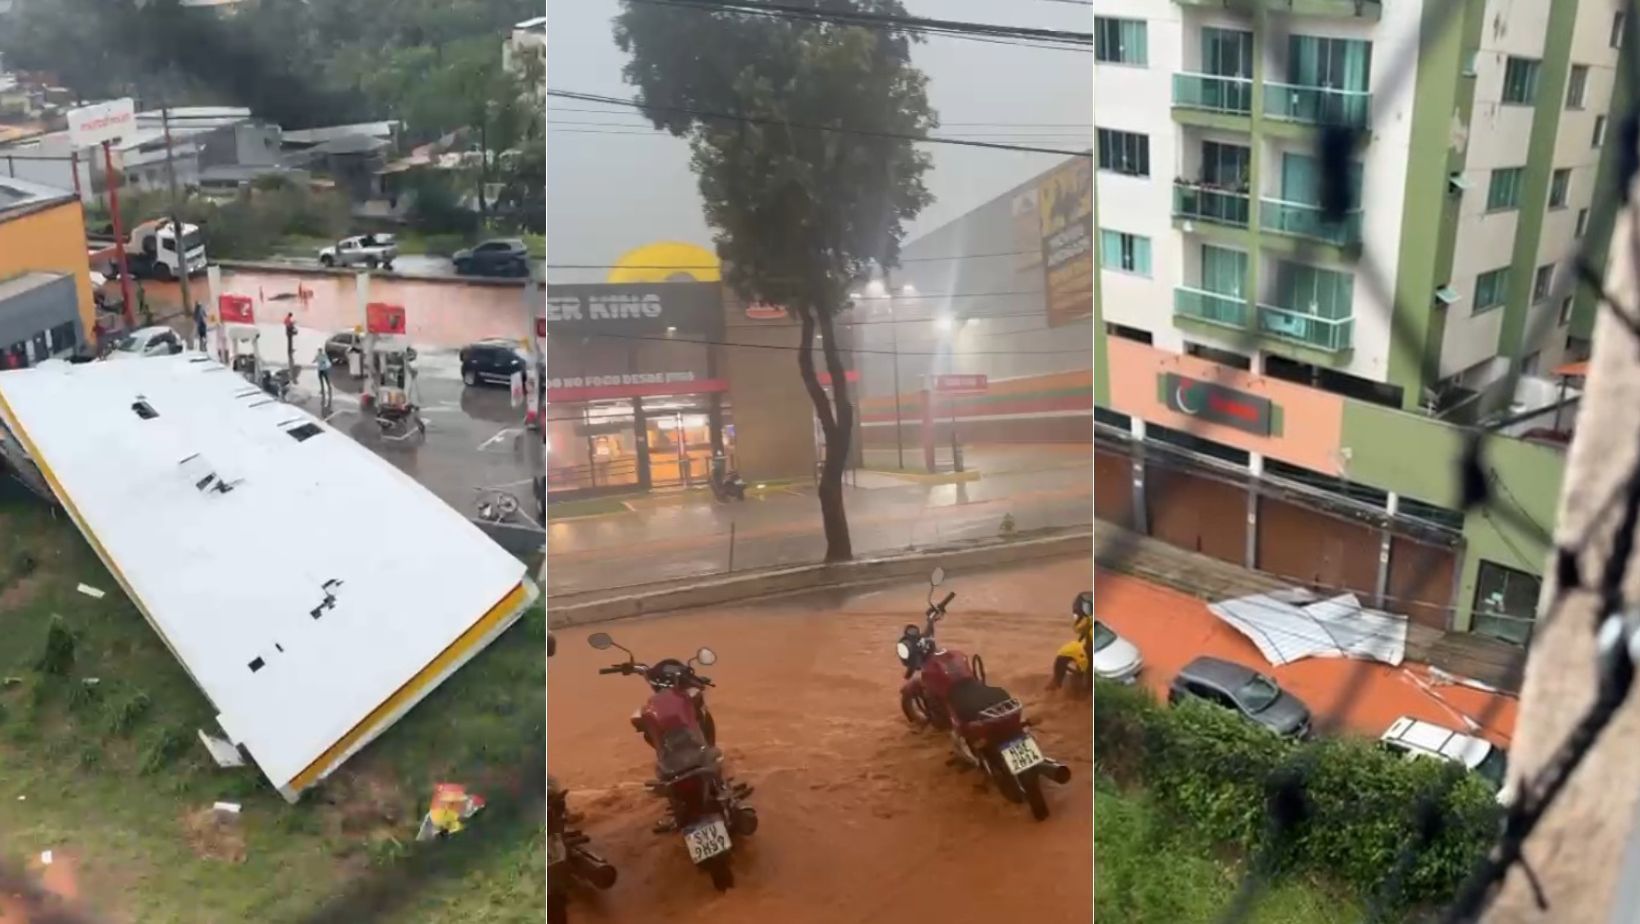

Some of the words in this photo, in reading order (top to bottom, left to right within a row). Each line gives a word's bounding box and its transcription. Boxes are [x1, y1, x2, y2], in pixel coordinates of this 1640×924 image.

[548, 297, 583, 320] ER
[588, 294, 662, 320] KING
[622, 373, 664, 385] DESDE
